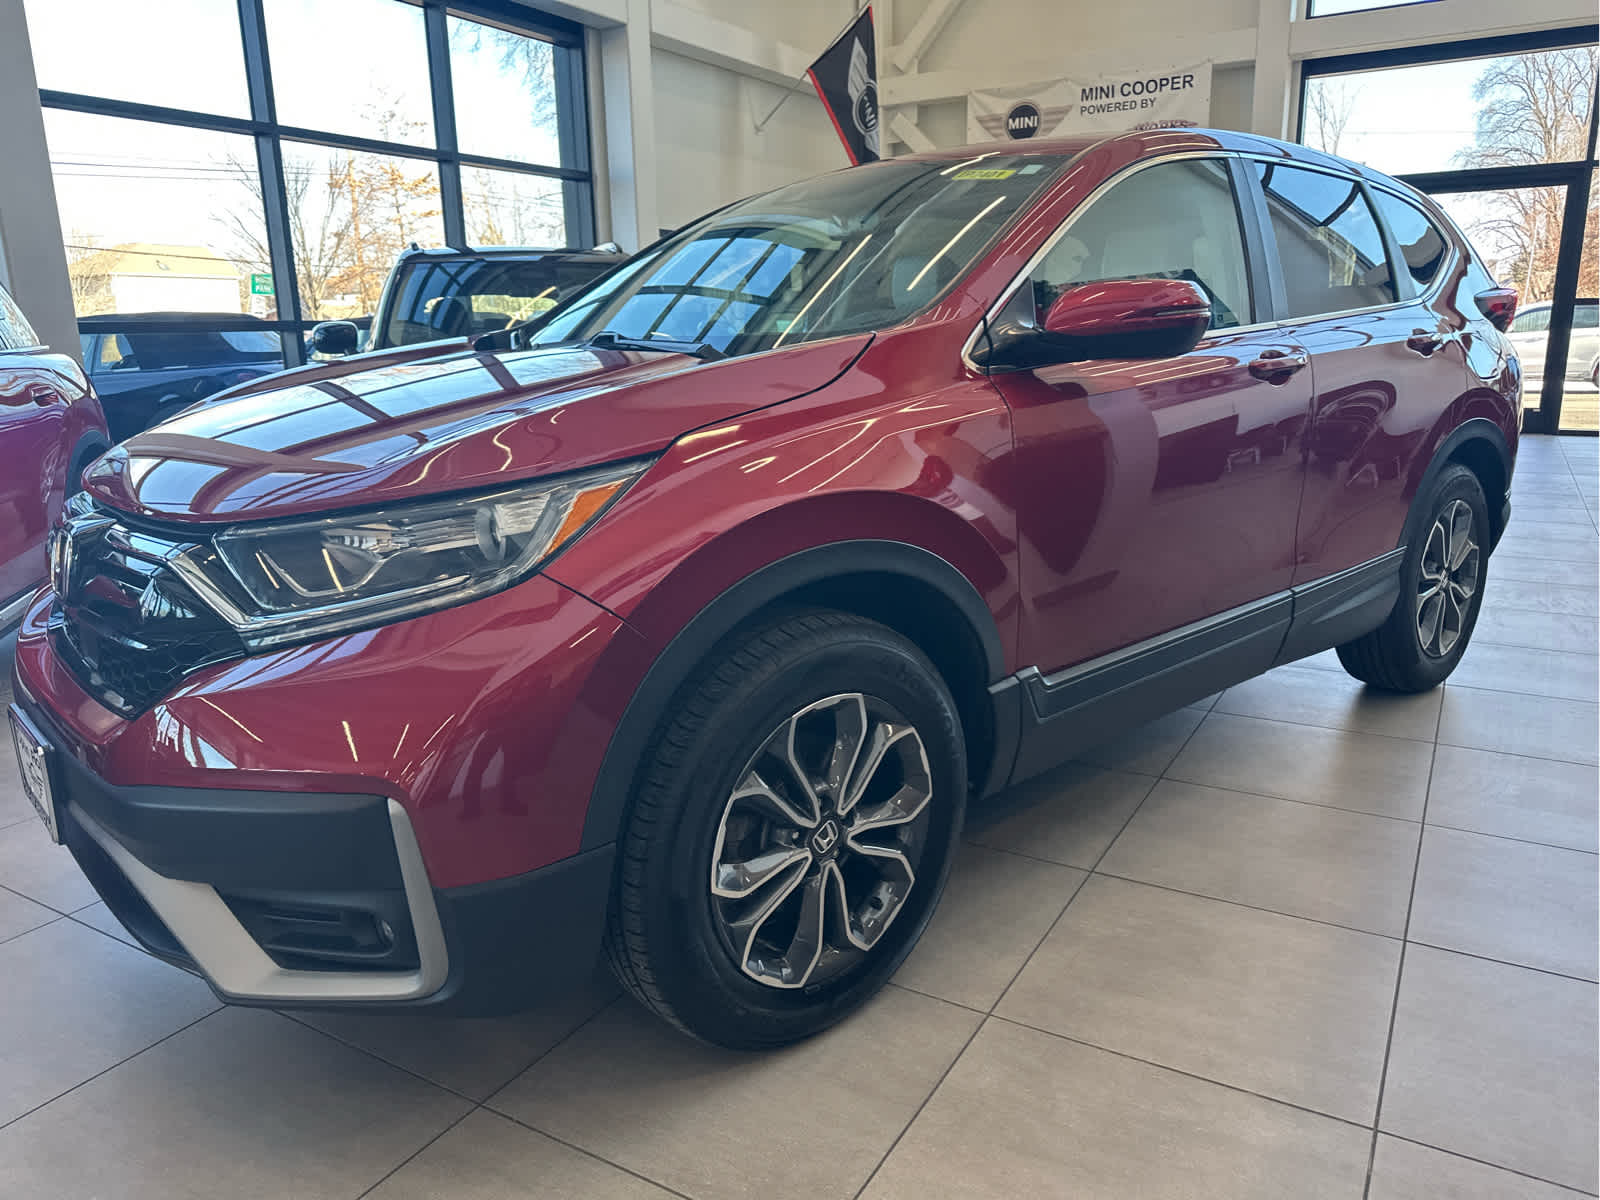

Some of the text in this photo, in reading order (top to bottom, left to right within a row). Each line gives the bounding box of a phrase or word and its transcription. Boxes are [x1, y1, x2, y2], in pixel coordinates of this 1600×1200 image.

[1080, 74, 1194, 102] MINI COOPER
[1080, 97, 1157, 116] POWERED BY
[1007, 114, 1038, 131] MINI
